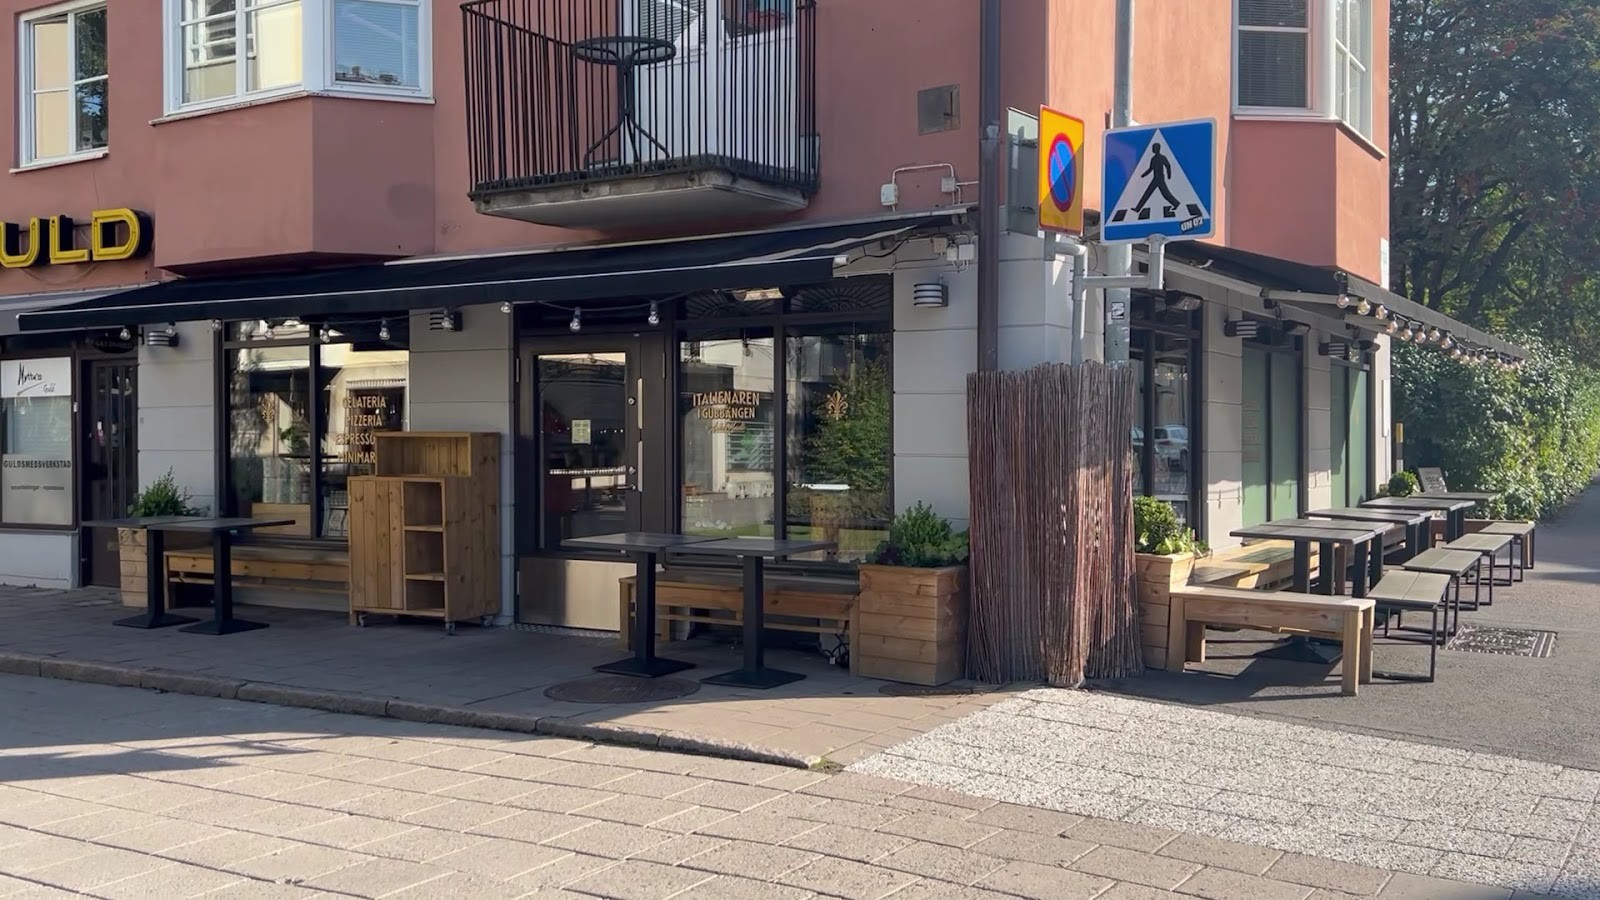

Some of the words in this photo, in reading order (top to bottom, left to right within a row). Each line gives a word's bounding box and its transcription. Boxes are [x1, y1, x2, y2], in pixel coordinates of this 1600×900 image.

[342, 395, 387, 409] GELATERIA
[692, 390, 760, 407] ITALIENAREN
[345, 414, 383, 427] PIZZERIA
[3, 459, 71, 469] GULDSMEDSVERKSTAD
